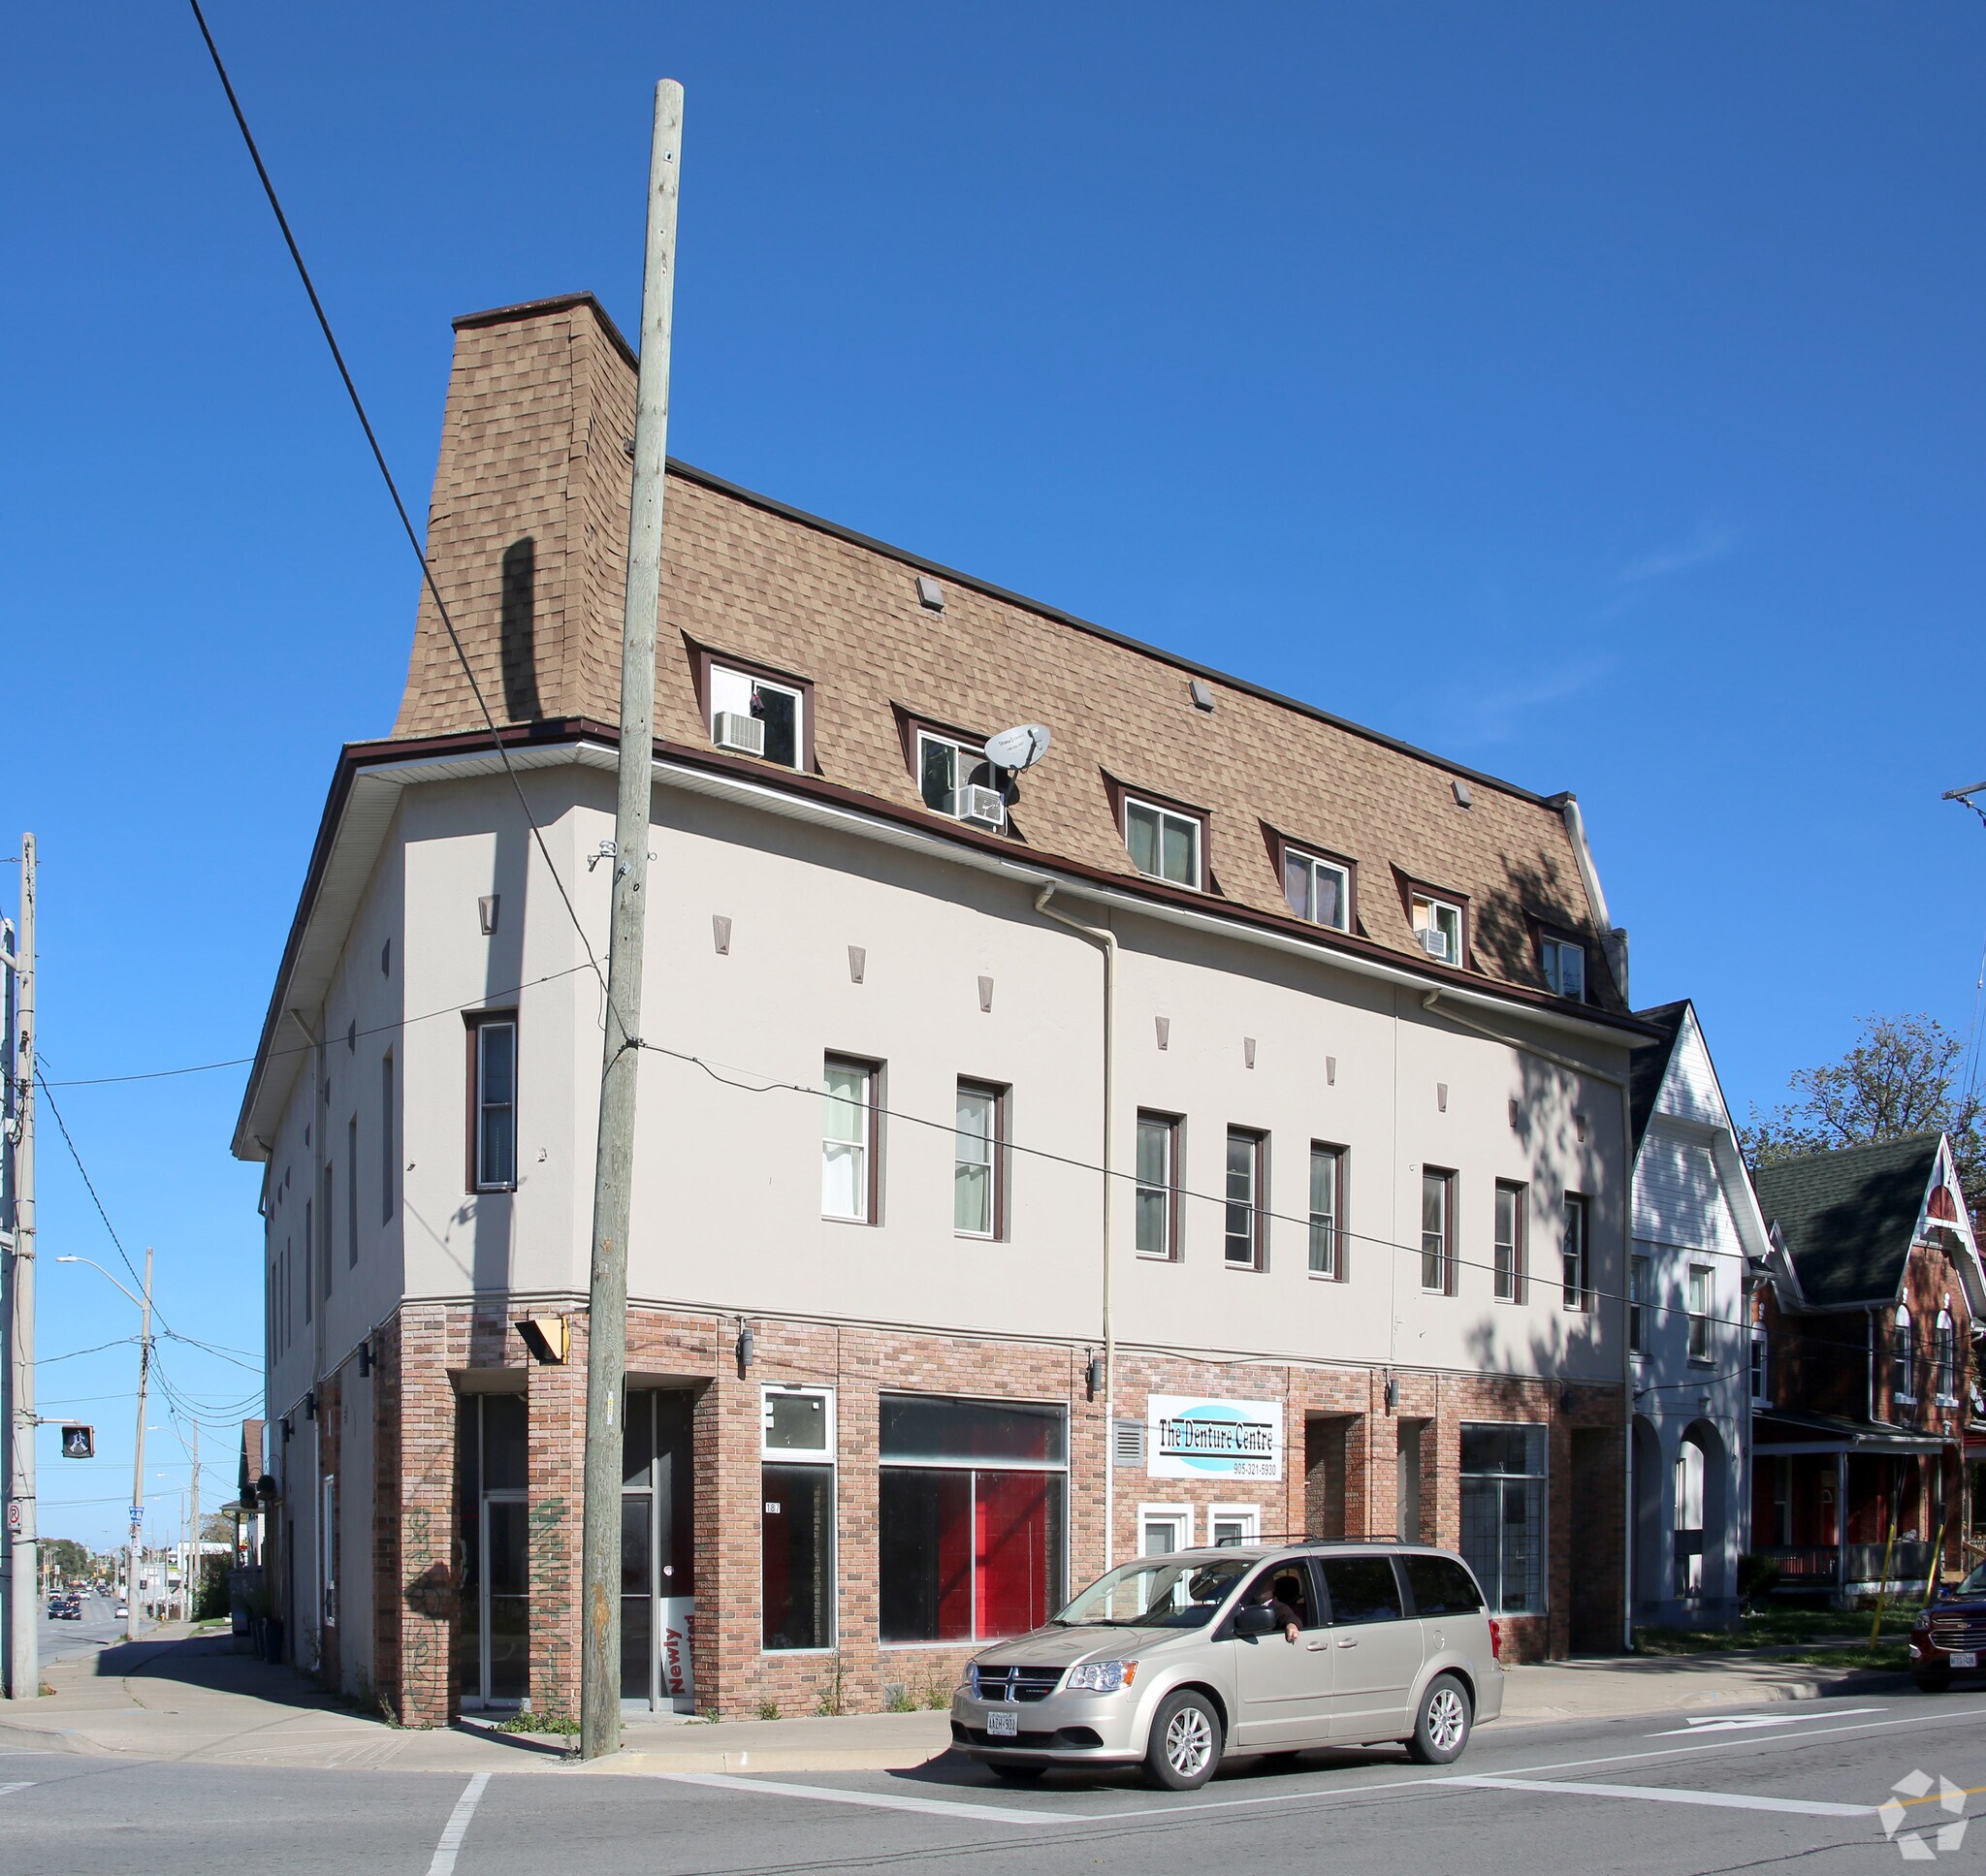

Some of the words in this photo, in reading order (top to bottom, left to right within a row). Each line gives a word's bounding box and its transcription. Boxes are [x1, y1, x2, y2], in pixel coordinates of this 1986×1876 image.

[1159, 1418, 1181, 1447] The
[1185, 1420, 1233, 1448] Denture
[1235, 1423, 1272, 1450] Centre
[1233, 1462, 1276, 1476] 905-321-5930
[767, 1503, 779, 1512] 187
[663, 1628, 686, 1694] Newly
